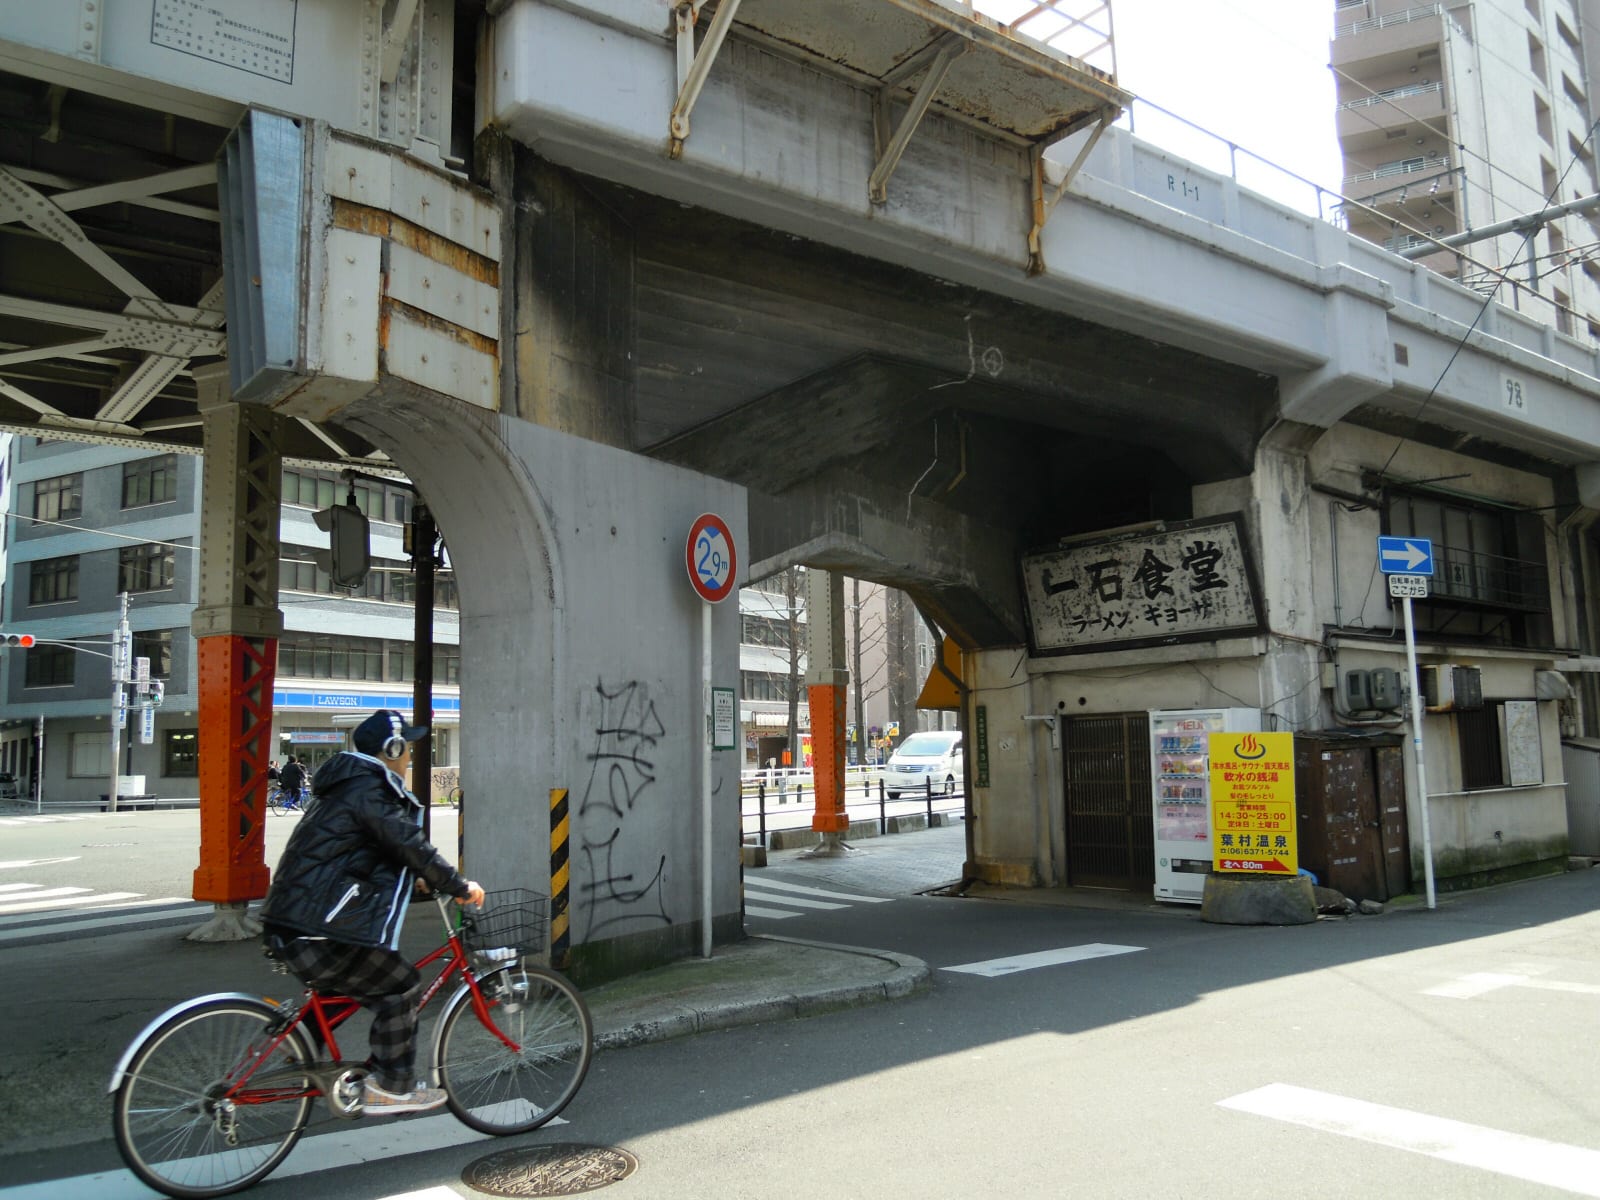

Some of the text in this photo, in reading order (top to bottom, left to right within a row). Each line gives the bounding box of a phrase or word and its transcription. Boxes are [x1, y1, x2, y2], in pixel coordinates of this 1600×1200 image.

[1167, 174, 1199, 201] R 1-1
[1506, 379, 1522, 408] 98
[1043, 540, 1229, 603] 一石食堂
[1392, 585, 1426, 596] ここから
[318, 696, 358, 706] LAWSON
[1220, 834, 1288, 848] 葉村温泉
